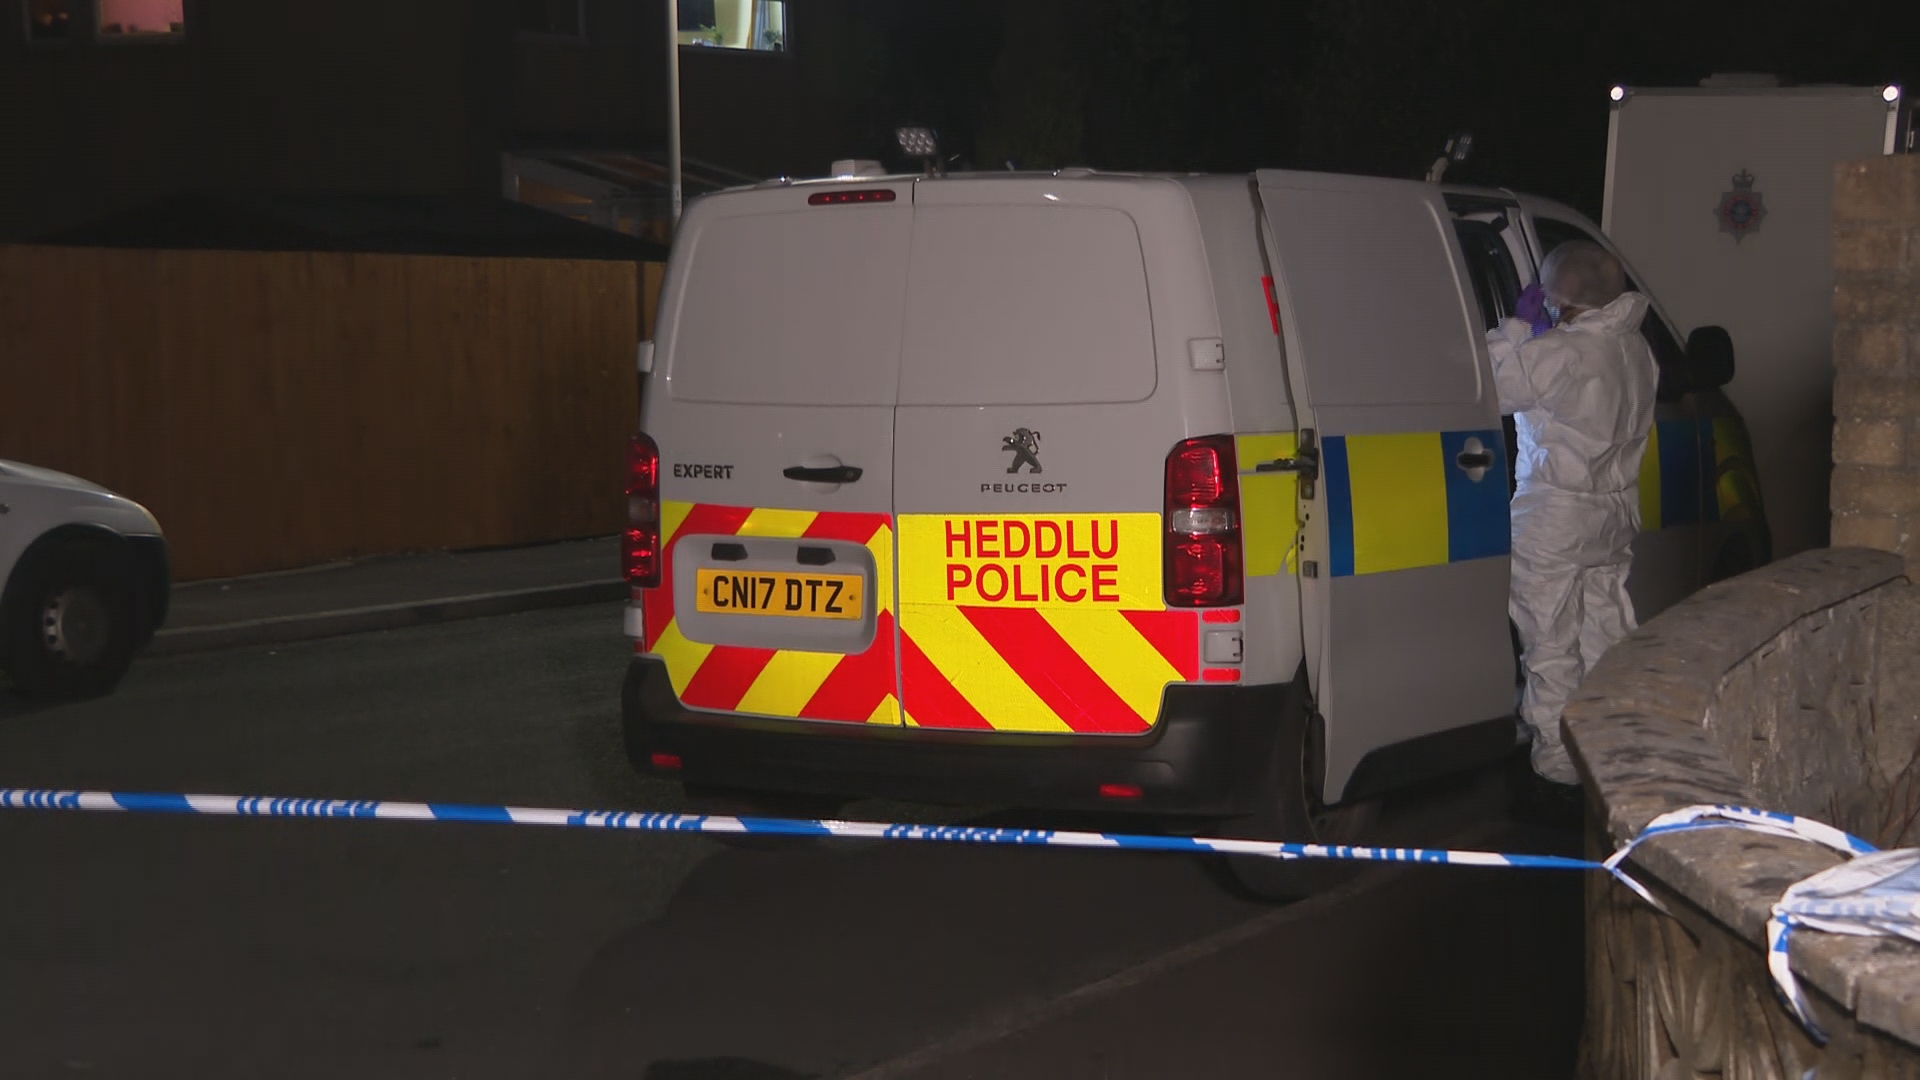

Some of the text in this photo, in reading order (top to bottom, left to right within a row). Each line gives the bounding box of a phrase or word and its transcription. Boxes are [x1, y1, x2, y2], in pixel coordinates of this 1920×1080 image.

[673, 463, 734, 480] EXPERT
[980, 483, 1068, 494] PEUGEOT
[944, 519, 1119, 560] HEDDLU
[713, 575, 844, 614] CN17 DTZ
[946, 563, 1120, 603] POLICE
